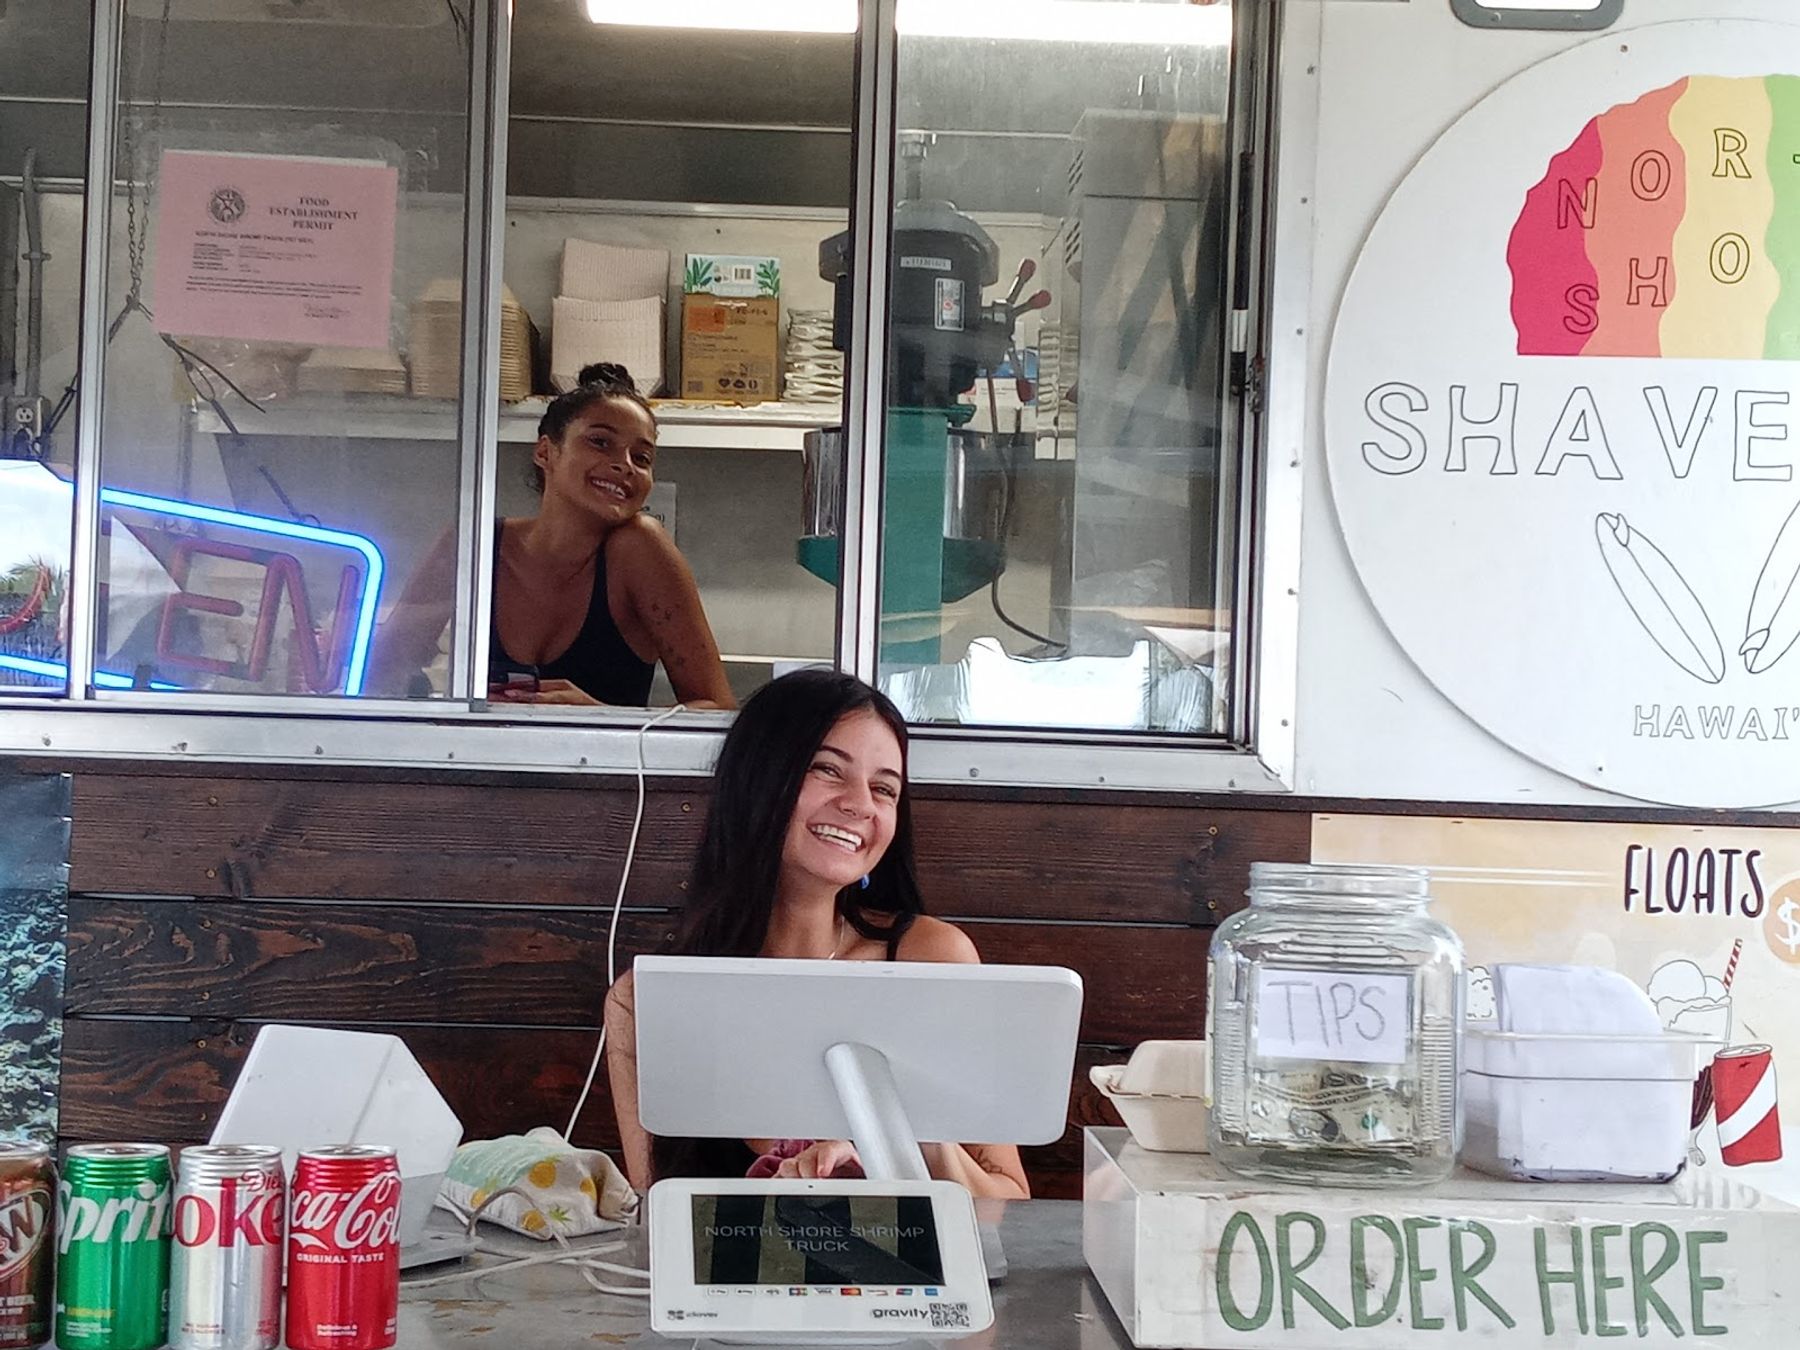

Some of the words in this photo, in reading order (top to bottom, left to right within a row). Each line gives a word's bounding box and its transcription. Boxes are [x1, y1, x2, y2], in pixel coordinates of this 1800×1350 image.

[1556, 127, 1800, 230] NOR
[269, 207, 358, 220] ESTABLISHMENT
[298, 197, 330, 207] FOOD
[293, 220, 334, 231] PERMIT
[1361, 381, 1793, 482] SHAVE
[1624, 844, 1764, 918] FLOATS
[1267, 980, 1387, 1048] TIPS
[57, 1180, 171, 1254] prit
[168, 1177, 285, 1248] oke
[704, 1225, 772, 1238] NORTH
[779, 1225, 844, 1238] SHORE
[850, 1225, 925, 1238] SHRIMP
[296, 1252, 348, 1264] ORIGINAL
[351, 1253, 385, 1263] TASTE
[785, 1239, 850, 1252] TRUCK
[1215, 1210, 1516, 1331] ORDER
[1533, 1222, 1729, 1338] HERE
[872, 1306, 929, 1320] gravity
